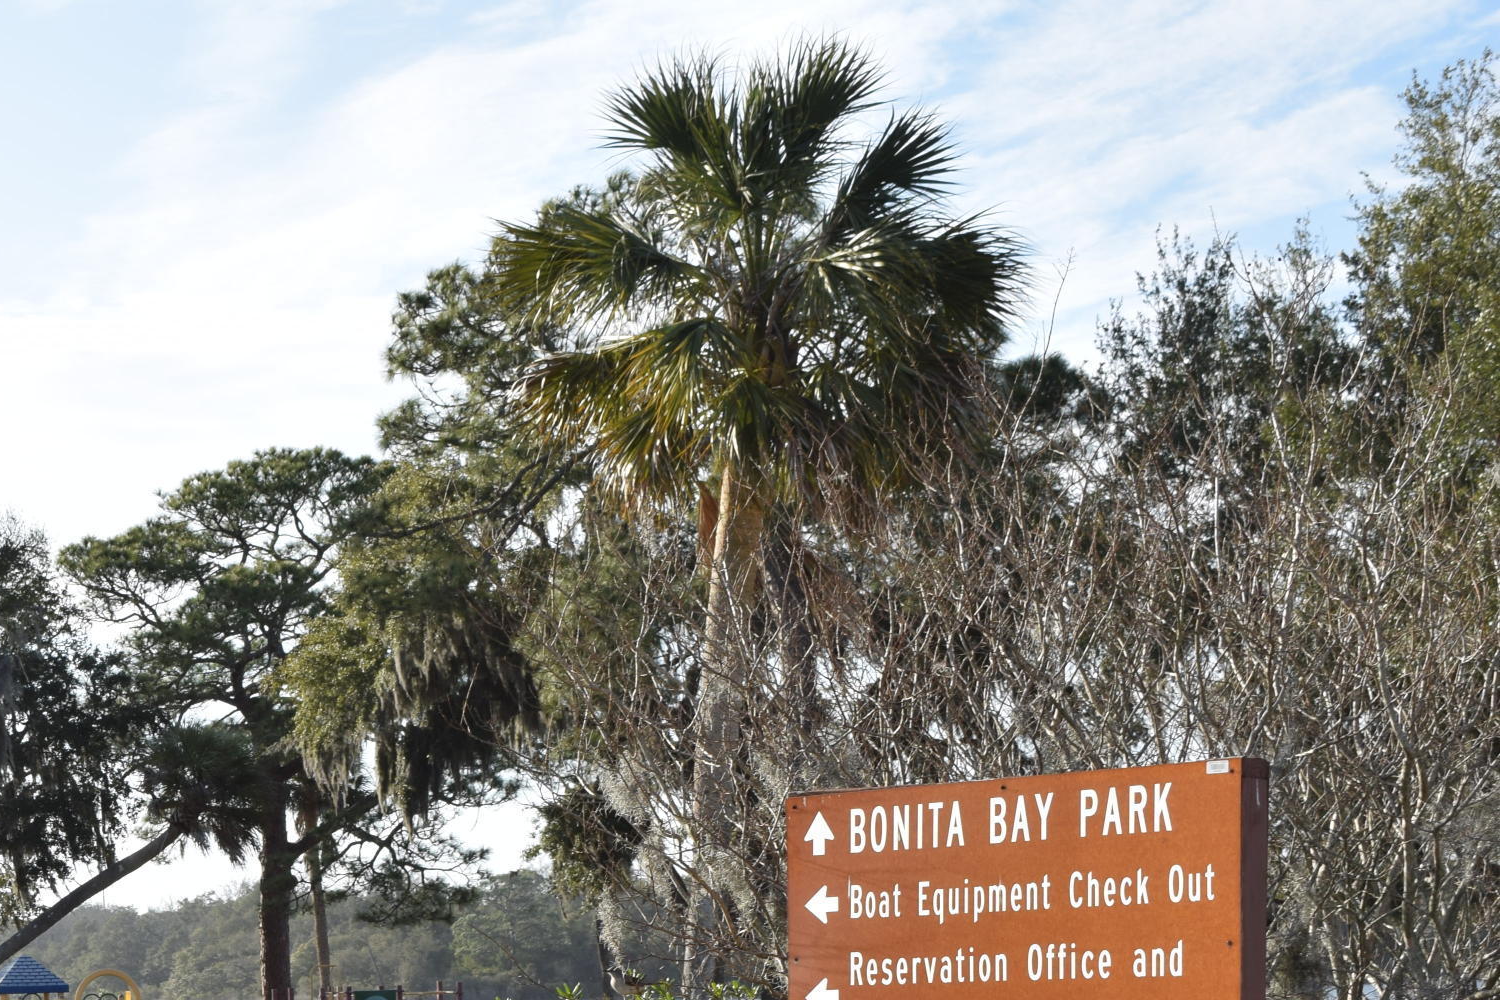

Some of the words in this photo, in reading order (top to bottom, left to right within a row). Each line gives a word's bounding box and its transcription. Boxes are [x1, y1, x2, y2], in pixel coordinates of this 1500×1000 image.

[849, 800, 965, 854] BONITA
[989, 791, 1054, 845] BAY
[1079, 781, 1173, 838] PARK
[849, 883, 902, 920] Boat
[917, 873, 1050, 924] Equipment
[1068, 867, 1150, 909] Check
[1168, 863, 1216, 904] Out
[849, 946, 1008, 986] Reservation
[1027, 942, 1112, 982] Office
[1132, 939, 1184, 978] and
